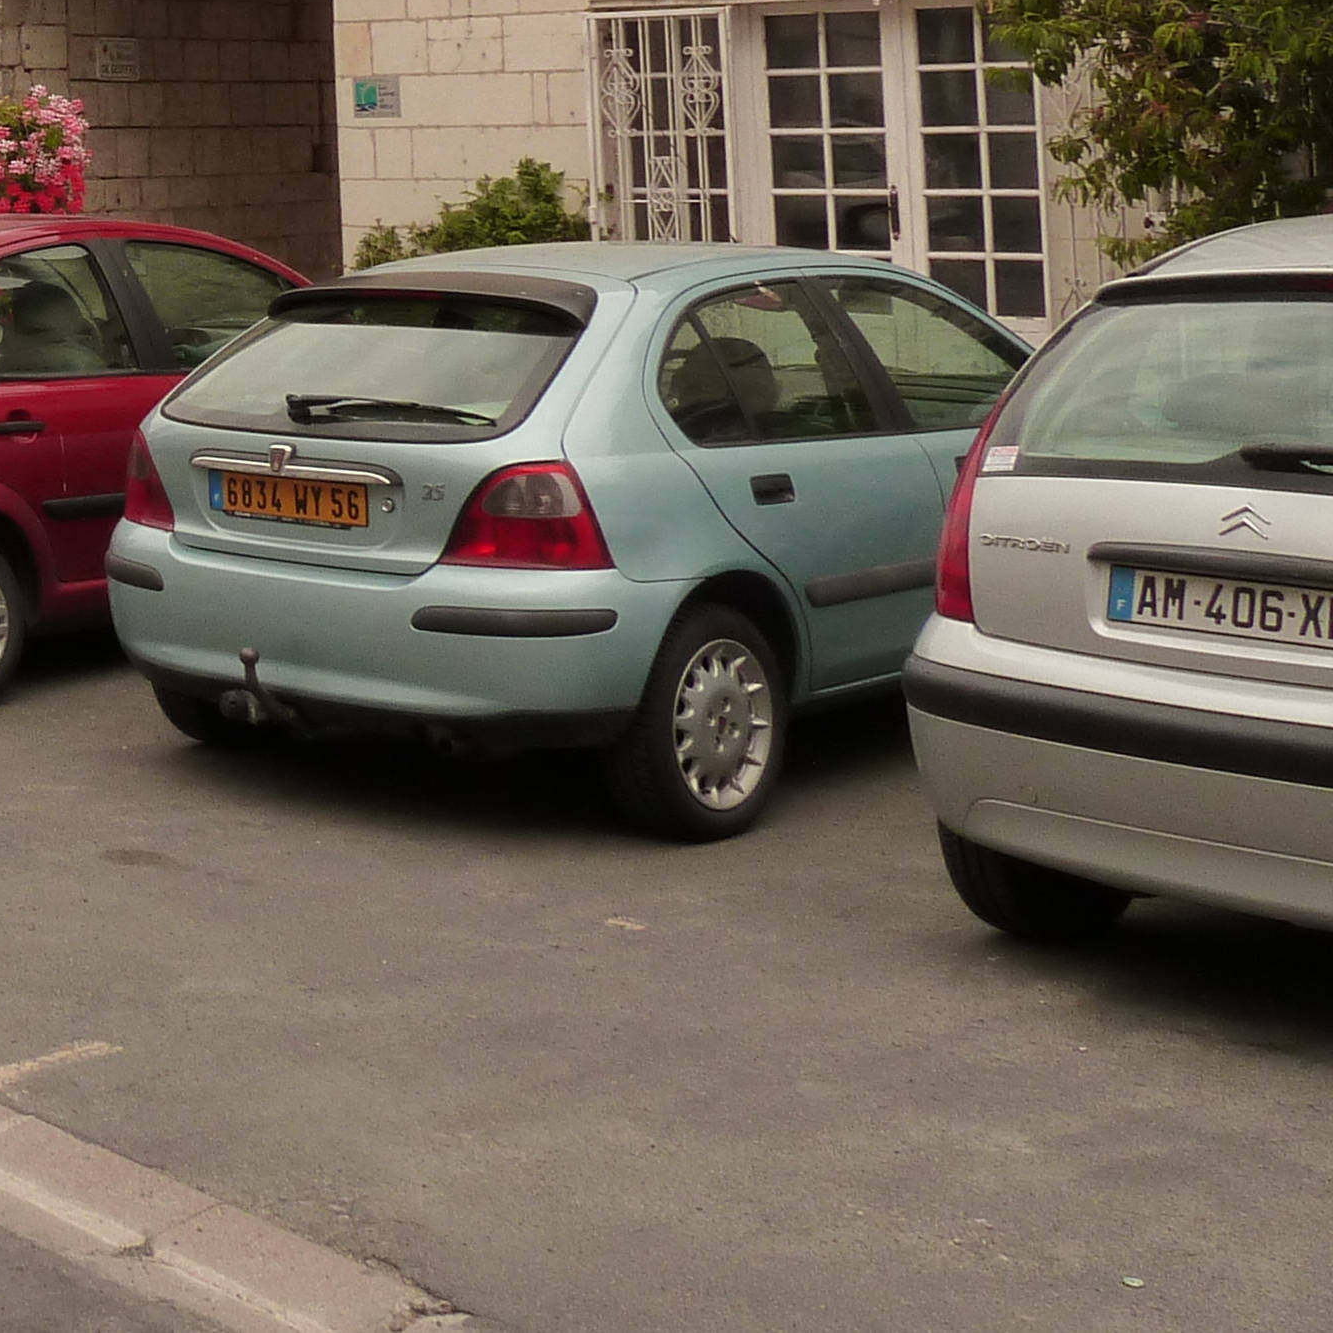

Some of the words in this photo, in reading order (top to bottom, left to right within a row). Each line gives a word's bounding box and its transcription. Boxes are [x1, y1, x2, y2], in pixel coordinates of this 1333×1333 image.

[226, 477, 283, 512] 6834
[293, 482, 323, 516] WY
[331, 486, 360, 520] 56
[979, 532, 1071, 554] CITROËN
[1116, 598, 1127, 611] F
